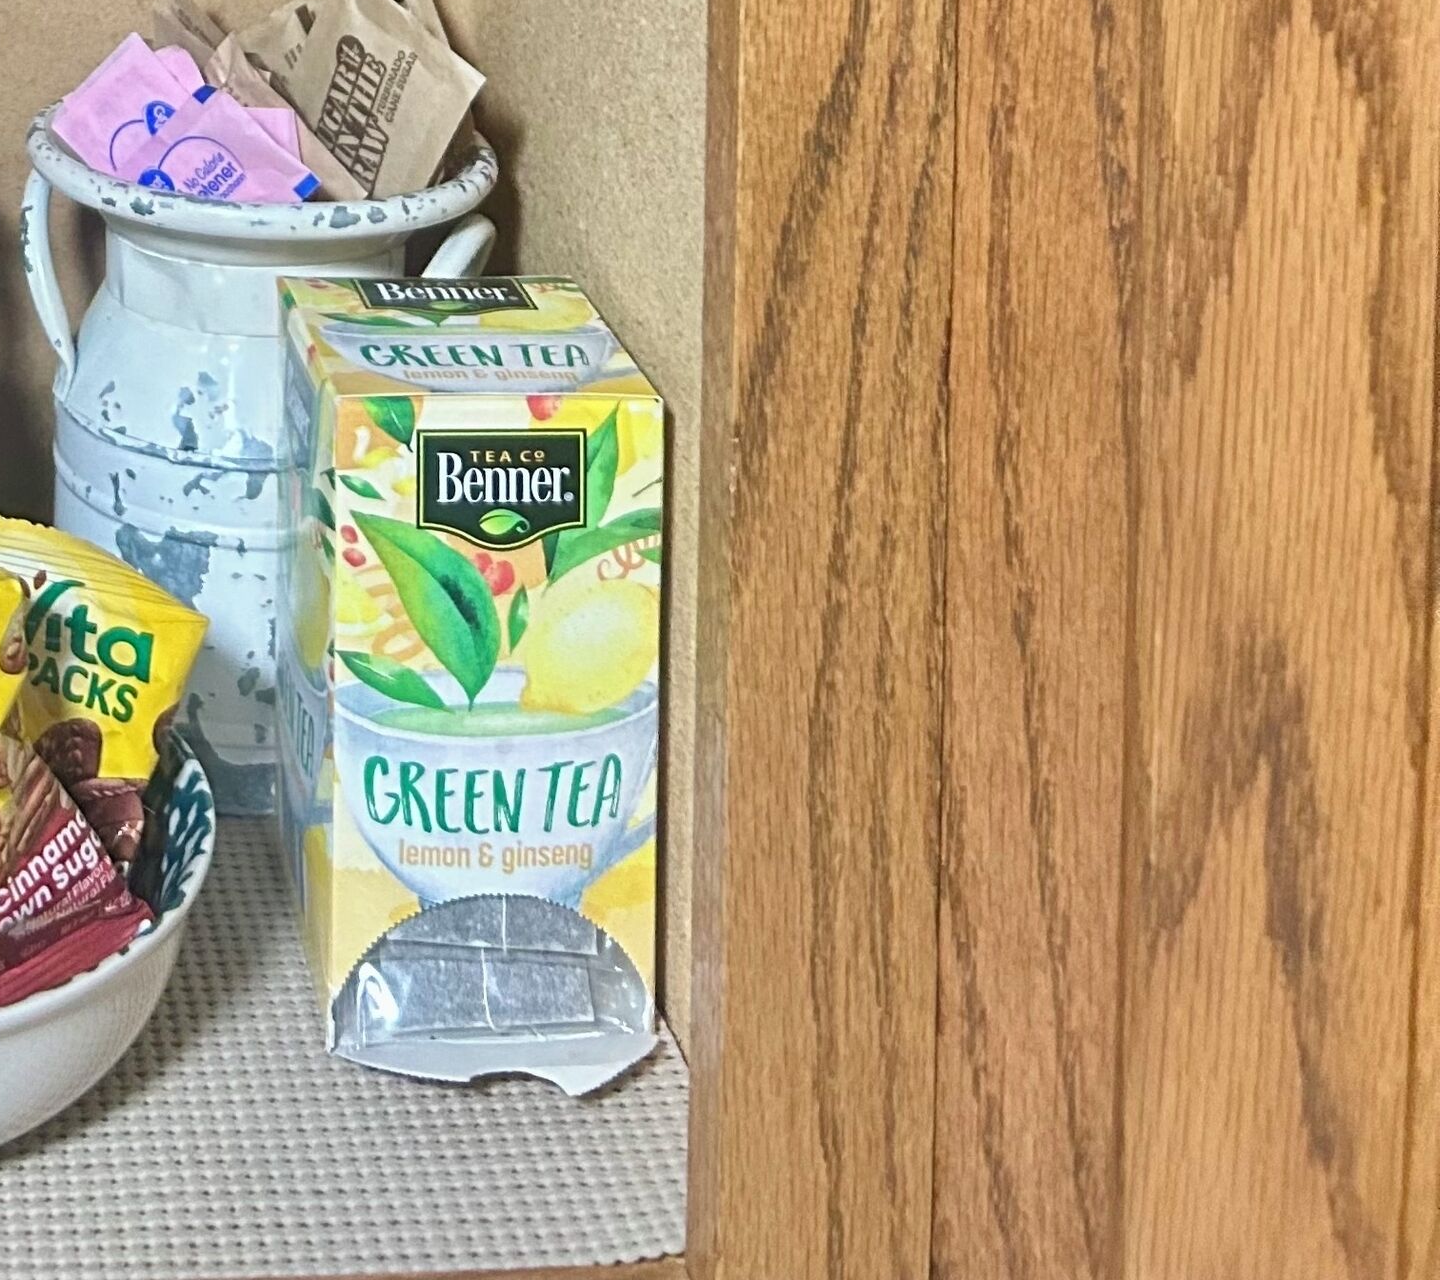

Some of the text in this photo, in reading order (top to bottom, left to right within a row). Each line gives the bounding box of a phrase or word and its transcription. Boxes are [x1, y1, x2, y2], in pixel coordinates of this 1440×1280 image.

[374, 282, 510, 302] Benner
[360, 343, 590, 368] GREEN TEA
[403, 368, 579, 383] lemon & ginseng
[470, 450, 512, 463] TEA
[436, 452, 571, 503] Benner
[363, 752, 623, 835] GREEN TEA
[398, 839, 594, 875] lemon & ginseng
